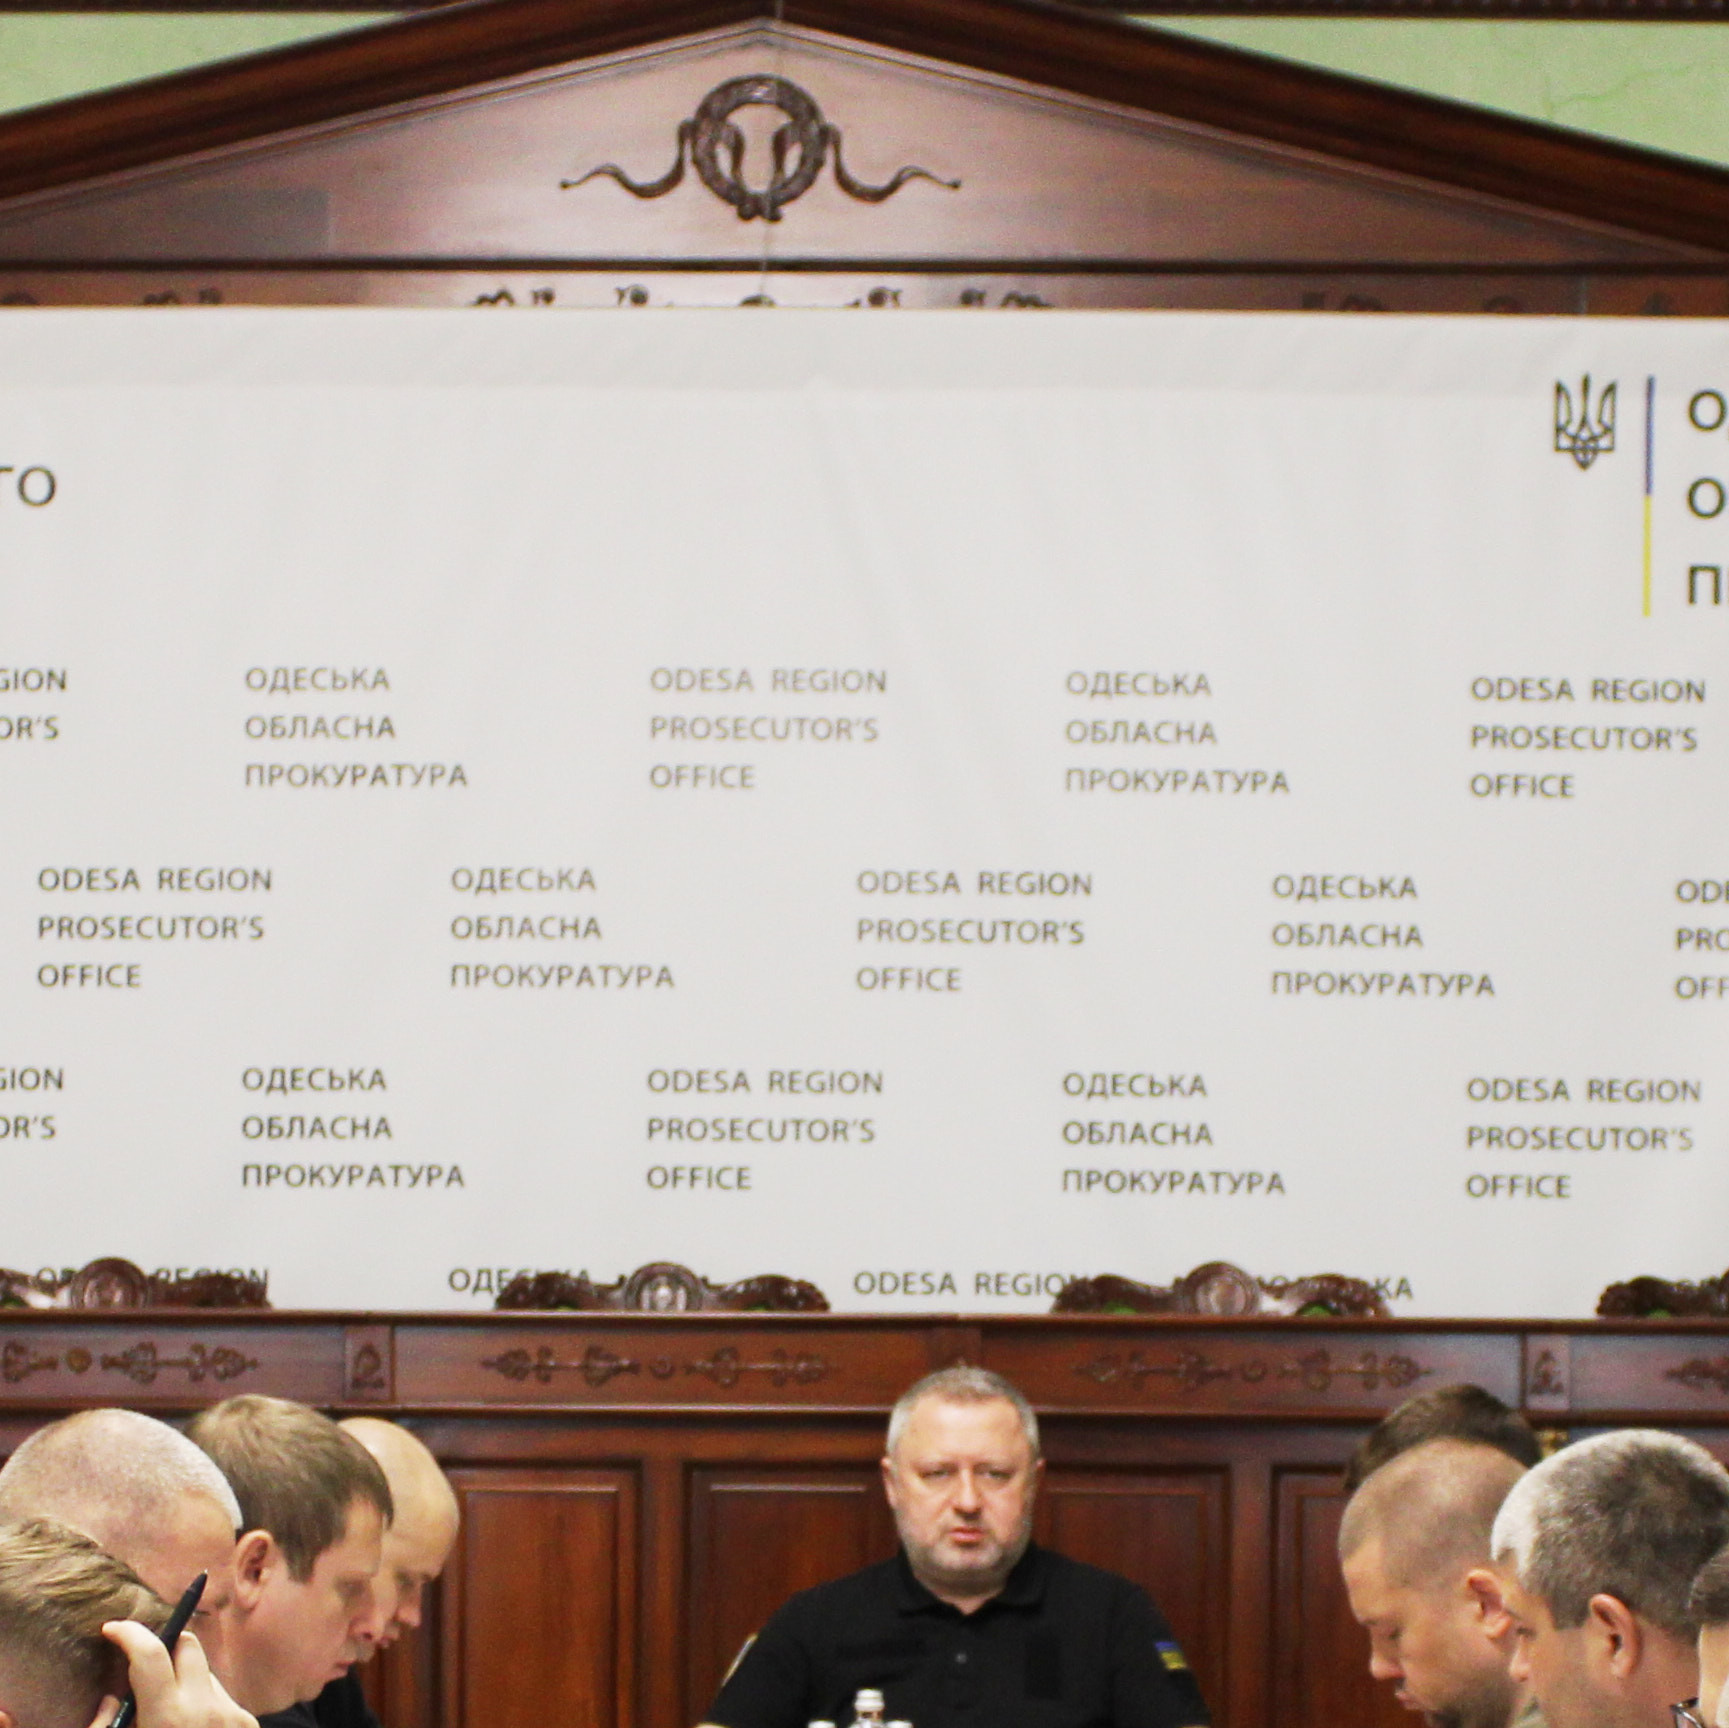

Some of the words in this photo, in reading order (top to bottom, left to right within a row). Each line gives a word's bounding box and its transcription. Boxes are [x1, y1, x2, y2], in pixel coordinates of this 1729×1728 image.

[244, 666, 390, 695] ОДЕСЬКА
[650, 667, 754, 692] ODESA
[772, 669, 887, 693] REGION
[1065, 671, 1211, 699] ОДЕСЬКА
[1469, 676, 1575, 702] ODESA
[1590, 677, 1706, 704] REGION
[244, 715, 396, 740] ОБЛАСНА
[650, 716, 878, 742] PROSECUTOR'S
[1065, 719, 1217, 744] ОБЛАСНА
[1470, 724, 1698, 753] PROSECUTOR'S
[245, 763, 468, 788] ПРОКУРАТУРА
[649, 764, 753, 789] OFFICE
[1065, 768, 1290, 794] ПРОКУРАТУРА
[1469, 772, 1574, 799] OFFICE
[37, 867, 141, 892] ODESA
[157, 867, 272, 892] REGION
[450, 867, 597, 896] ОДЕСЬКА
[856, 870, 961, 895] ODESA
[977, 870, 1092, 897] REGION
[1271, 874, 1418, 903] ОДЕСЬКА
[37, 915, 265, 941] PROSECUTOR'S
[450, 915, 602, 940] ОБЛАСНА
[857, 918, 1085, 946] PROSECUTOR'S
[1270, 922, 1424, 948] ОБЛАСНА
[36, 963, 140, 989] OFFICE
[450, 963, 675, 989] ПРОКУРАТУРА
[855, 966, 960, 992] OFFICE
[1271, 970, 1495, 997] ПРОКУРАТУРА
[241, 1066, 387, 1096] ОДЕСЬКА
[646, 1068, 751, 1094] ODESA
[767, 1069, 883, 1095] REGION
[1061, 1071, 1208, 1101] ОДЕСЬКА
[1465, 1077, 1571, 1103] ODESA
[1586, 1077, 1701, 1104] REGION
[241, 1115, 393, 1141] ОБЛАСНА
[646, 1116, 876, 1144] PROSECUTOR'S
[1061, 1119, 1214, 1147] ОБЛАСНА
[1465, 1125, 1693, 1152] PROSECUTOR'S
[241, 1163, 465, 1189] ПРОКУРАТУРА
[645, 1165, 751, 1191] OFFICE
[1062, 1168, 1286, 1196] ПРОКУРАТУРА
[1464, 1173, 1570, 1200] OFFICE
[853, 1271, 957, 1296] ODESA
[974, 1272, 1094, 1297] REGIO
